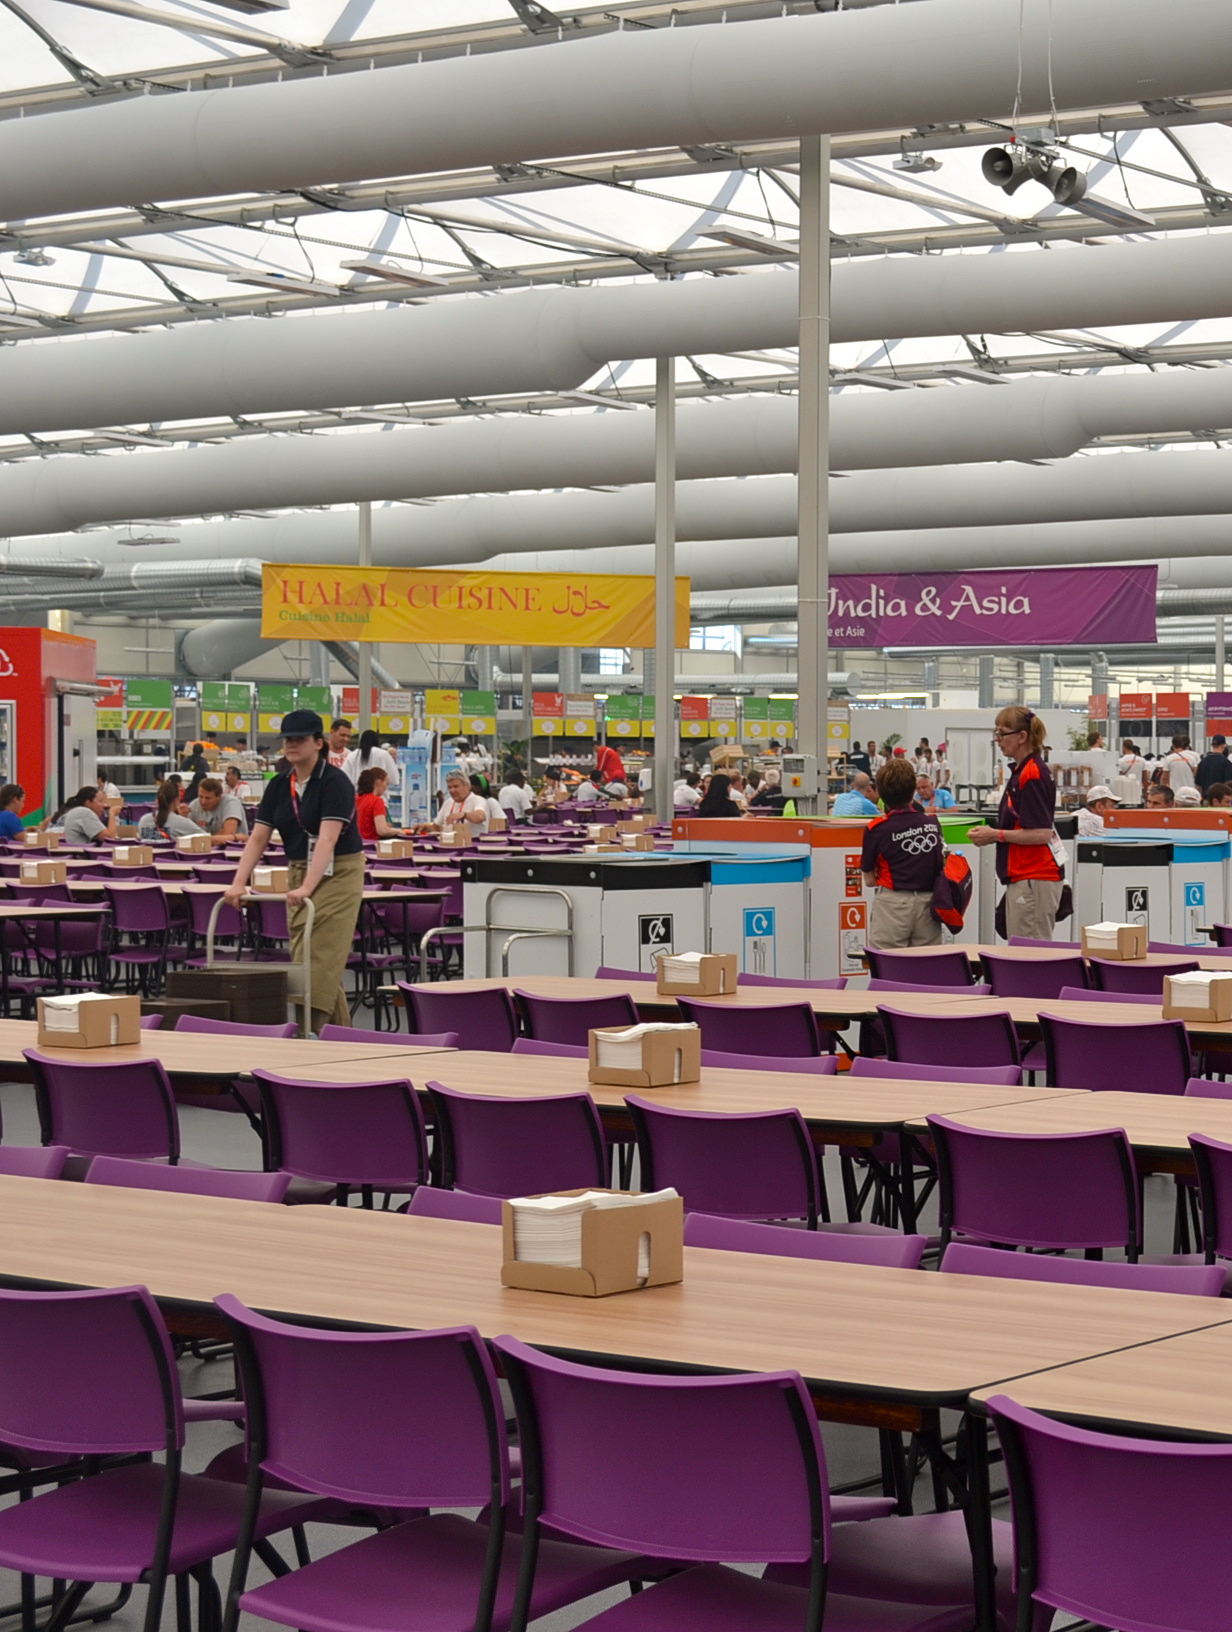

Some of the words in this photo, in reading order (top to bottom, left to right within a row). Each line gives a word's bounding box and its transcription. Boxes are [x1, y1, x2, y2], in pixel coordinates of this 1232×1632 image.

[280, 579, 398, 607] HALAL
[407, 583, 542, 612] CUISINE
[552, 584, 611, 618] حلال
[914, 586, 942, 616] &
[946, 585, 1032, 620] Asia
[279, 610, 331, 623] Cuisine
[334, 611, 371, 624] Halal
[834, 627, 845, 637] et
[846, 625, 865, 637] Asie
[892, 827, 923, 841] London
